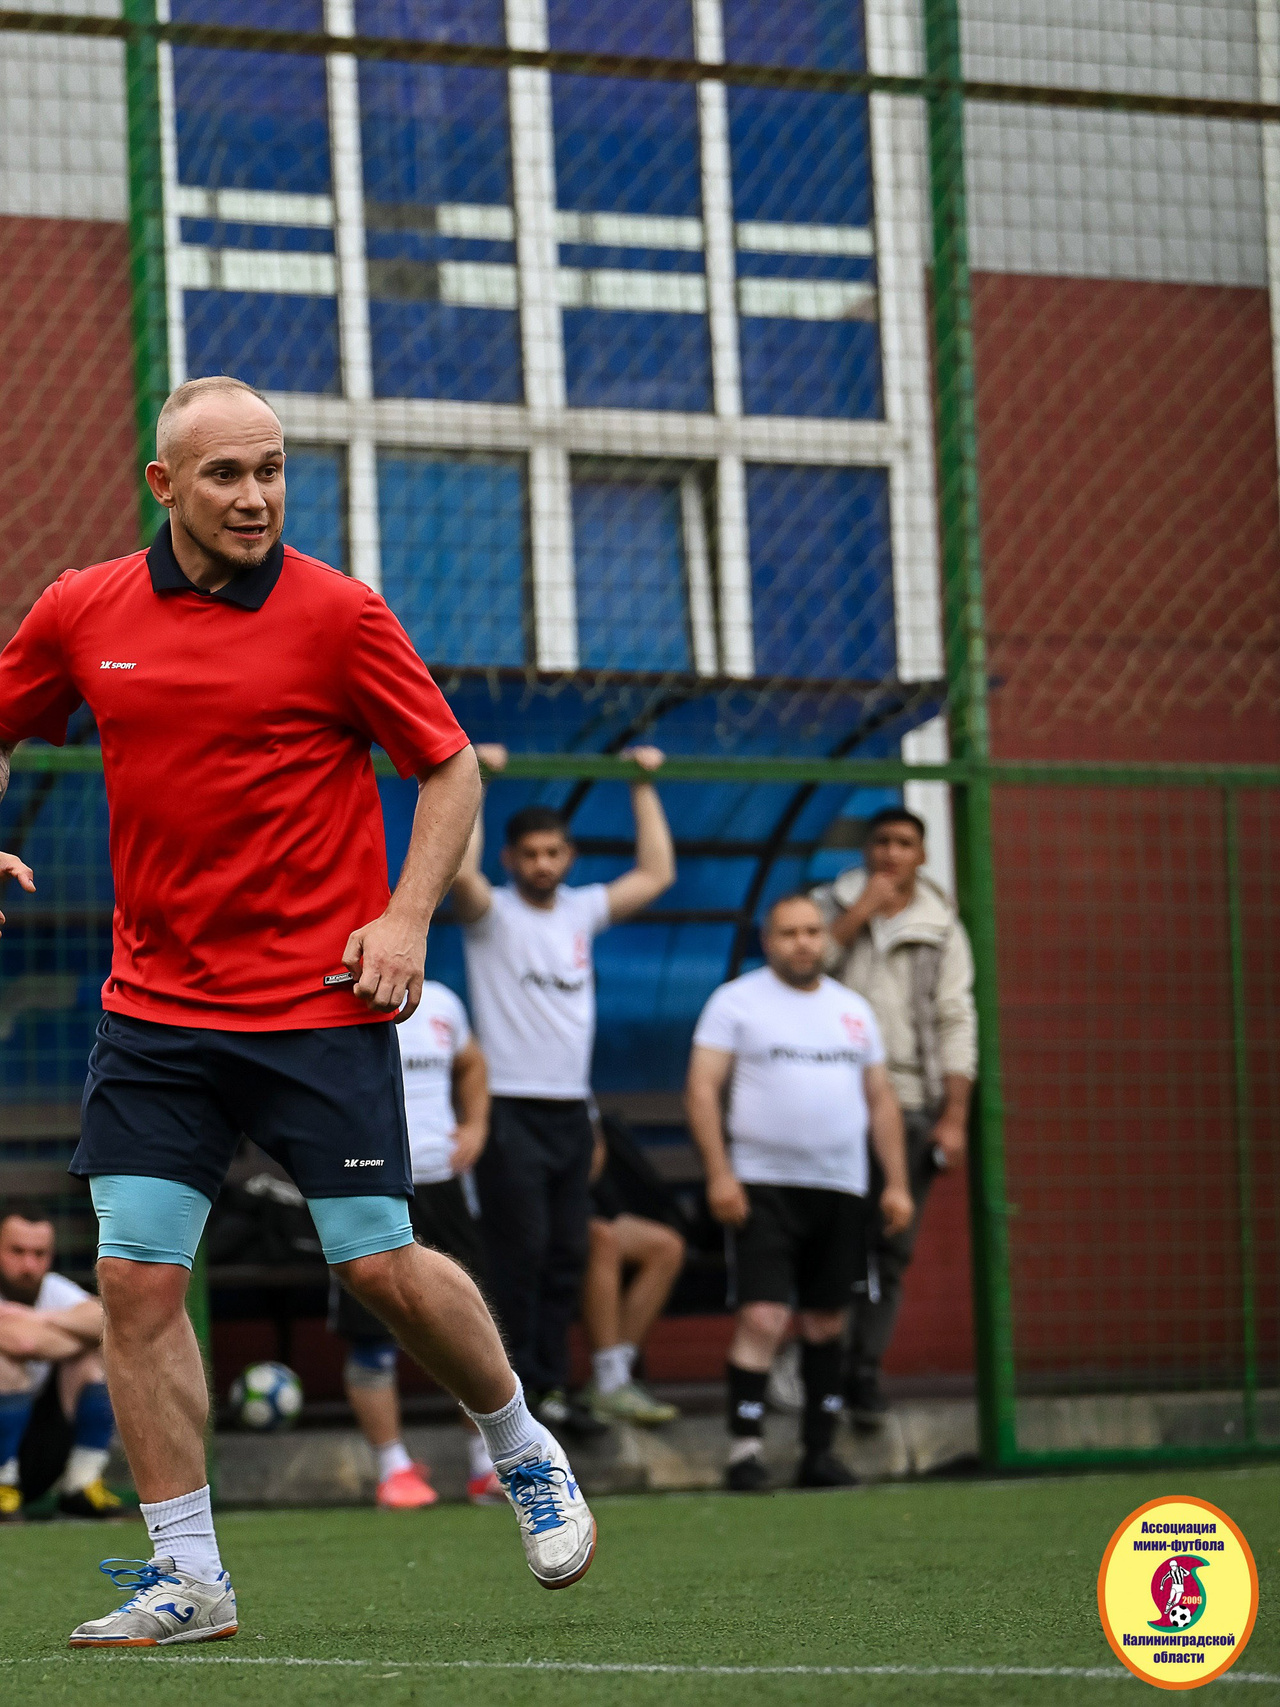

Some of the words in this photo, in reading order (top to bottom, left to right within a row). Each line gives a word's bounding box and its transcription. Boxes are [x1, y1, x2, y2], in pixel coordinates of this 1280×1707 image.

[100, 661, 113, 669] 2K
[111, 662, 137, 670] SPORT
[344, 1159, 359, 1167] 2K
